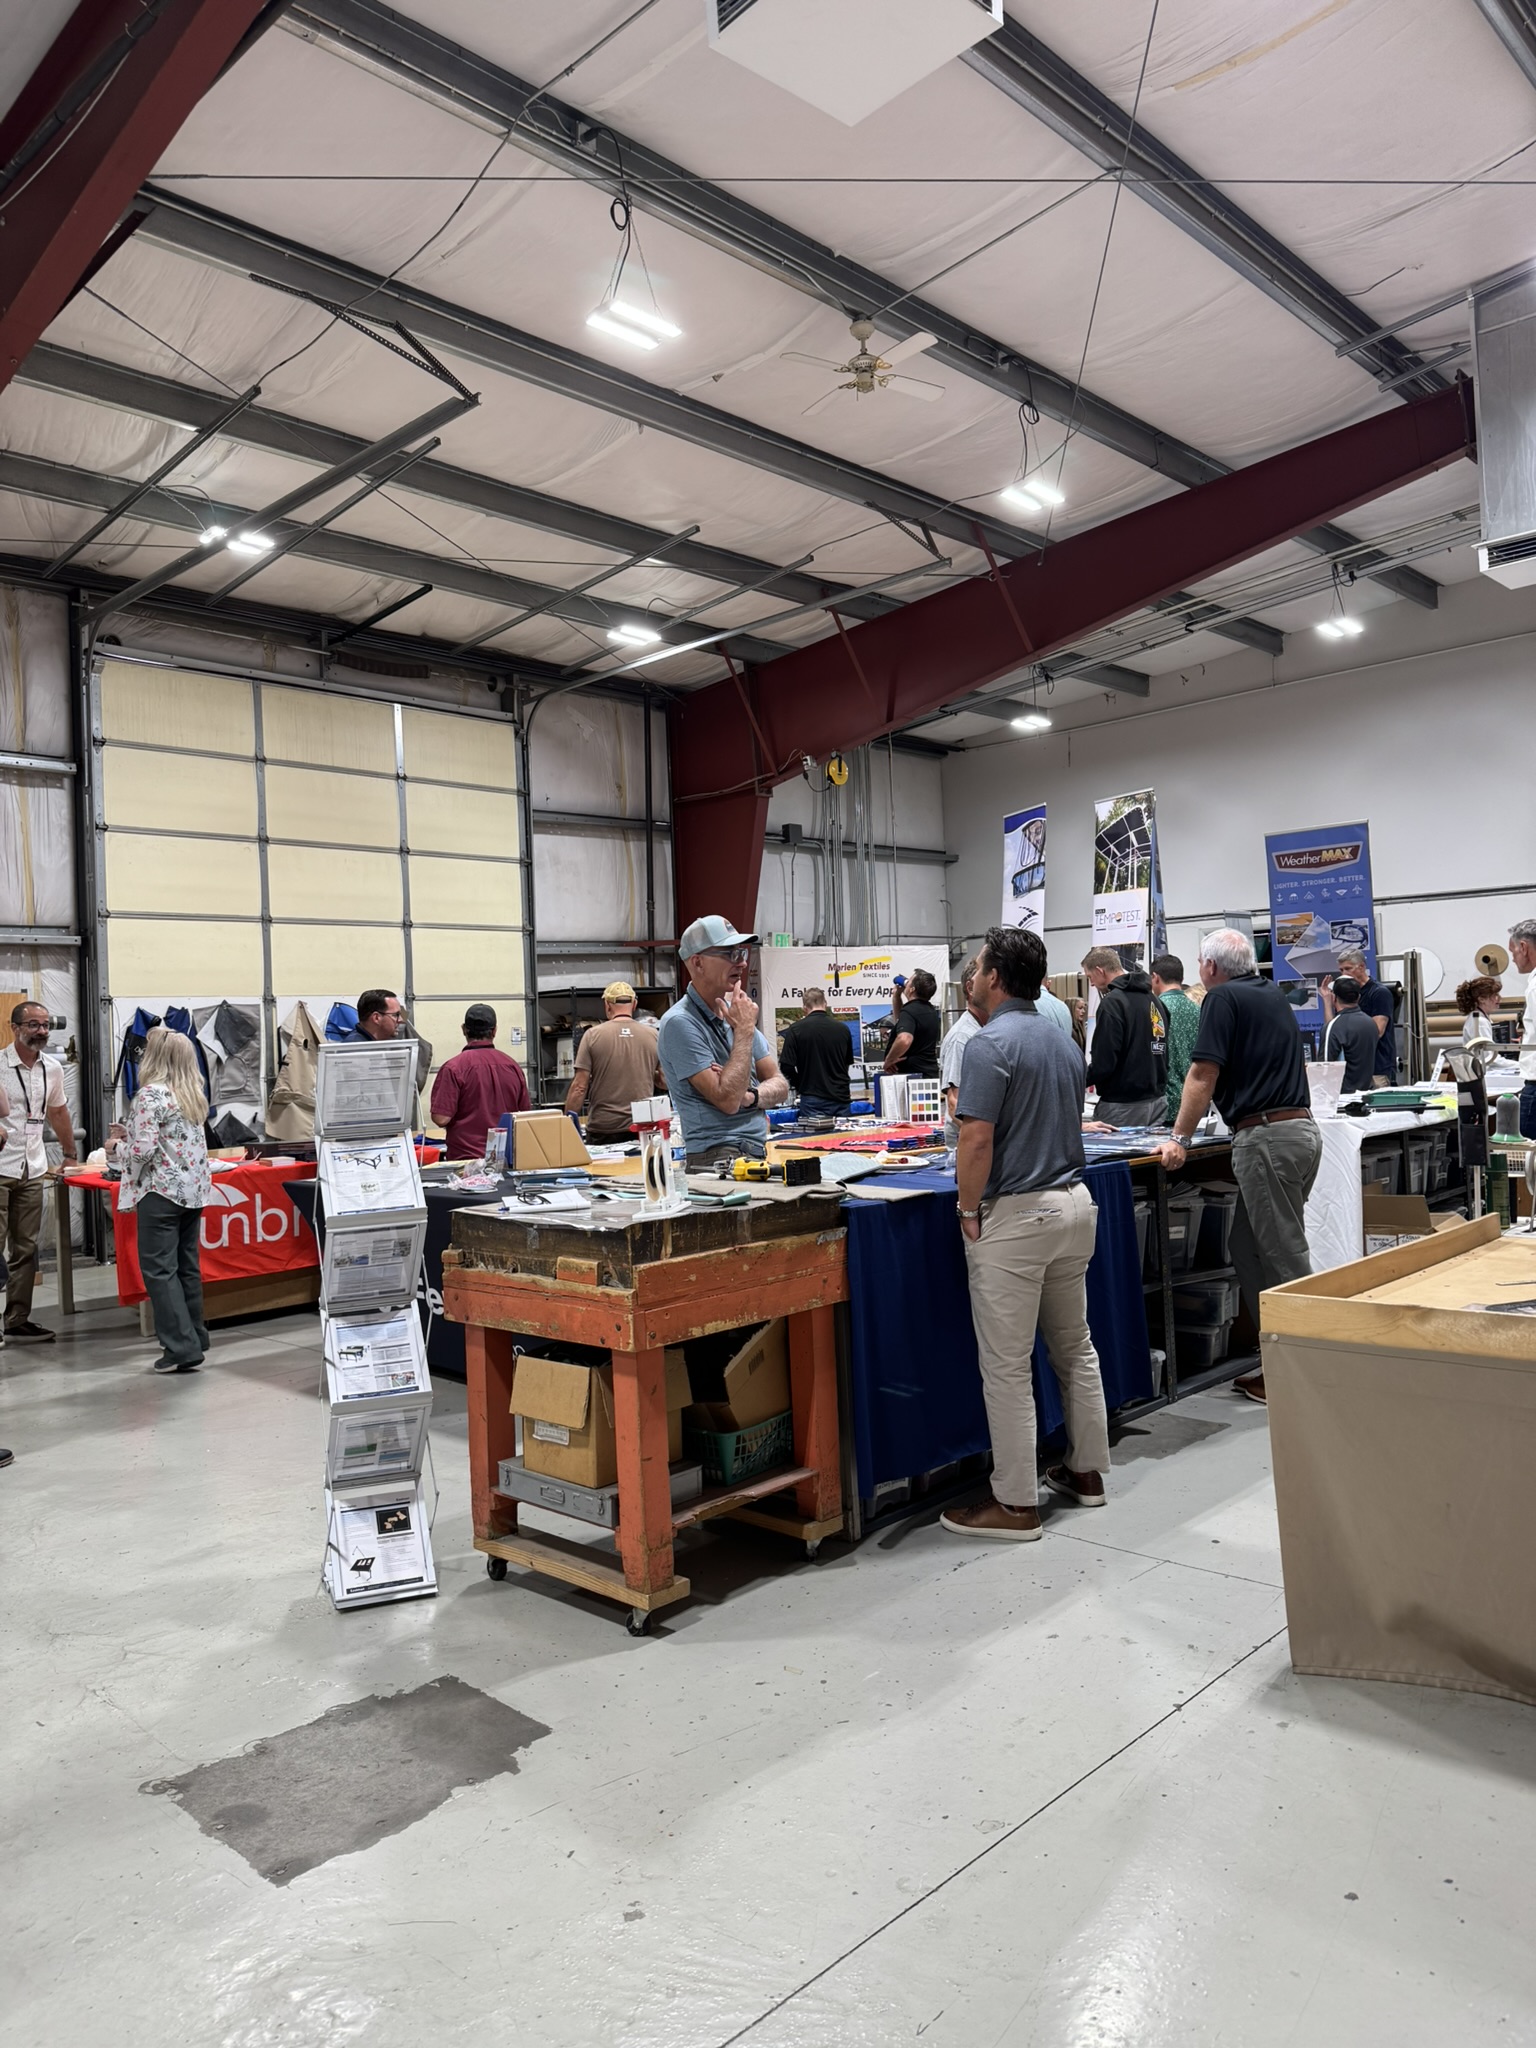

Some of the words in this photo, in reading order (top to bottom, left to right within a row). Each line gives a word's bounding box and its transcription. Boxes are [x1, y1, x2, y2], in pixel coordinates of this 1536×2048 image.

[1273, 881, 1300, 890] LIGHTER.
[1301, 877, 1337, 887] STRONGER.
[1338, 874, 1366, 883] BETTER.
[859, 961, 891, 971] Textiles
[781, 988, 790, 998] A
[828, 986, 843, 997] for
[845, 986, 874, 998] Every
